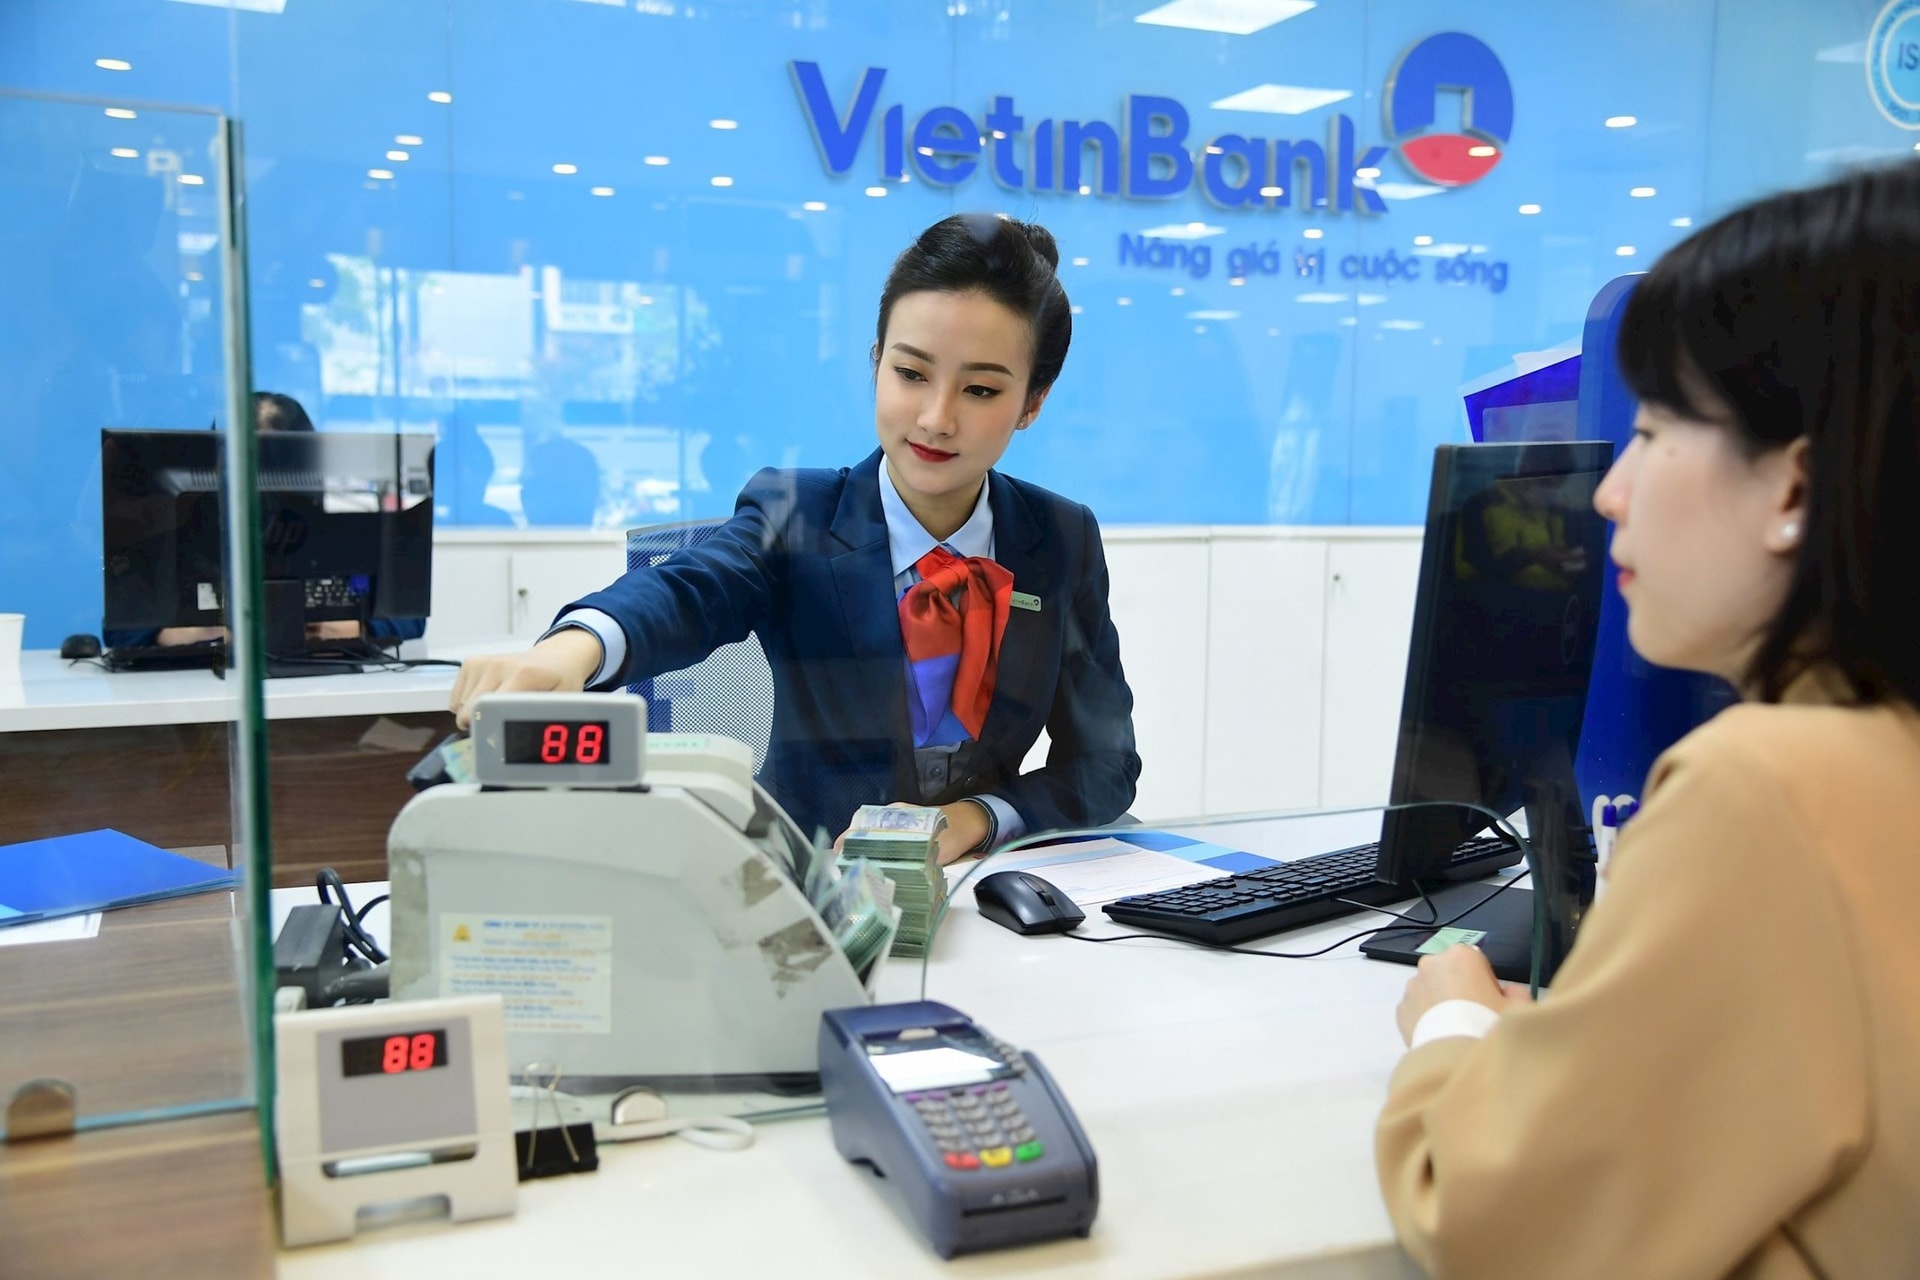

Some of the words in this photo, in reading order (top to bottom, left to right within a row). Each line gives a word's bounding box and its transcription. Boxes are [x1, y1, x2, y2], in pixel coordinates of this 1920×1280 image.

[788, 59, 1389, 214] VietinBank
[1227, 240, 1281, 280] giá
[1339, 249, 1421, 287] cuộc
[1434, 246, 1509, 294] sống
[541, 724, 603, 764] 88
[382, 1033, 435, 1074] 88
